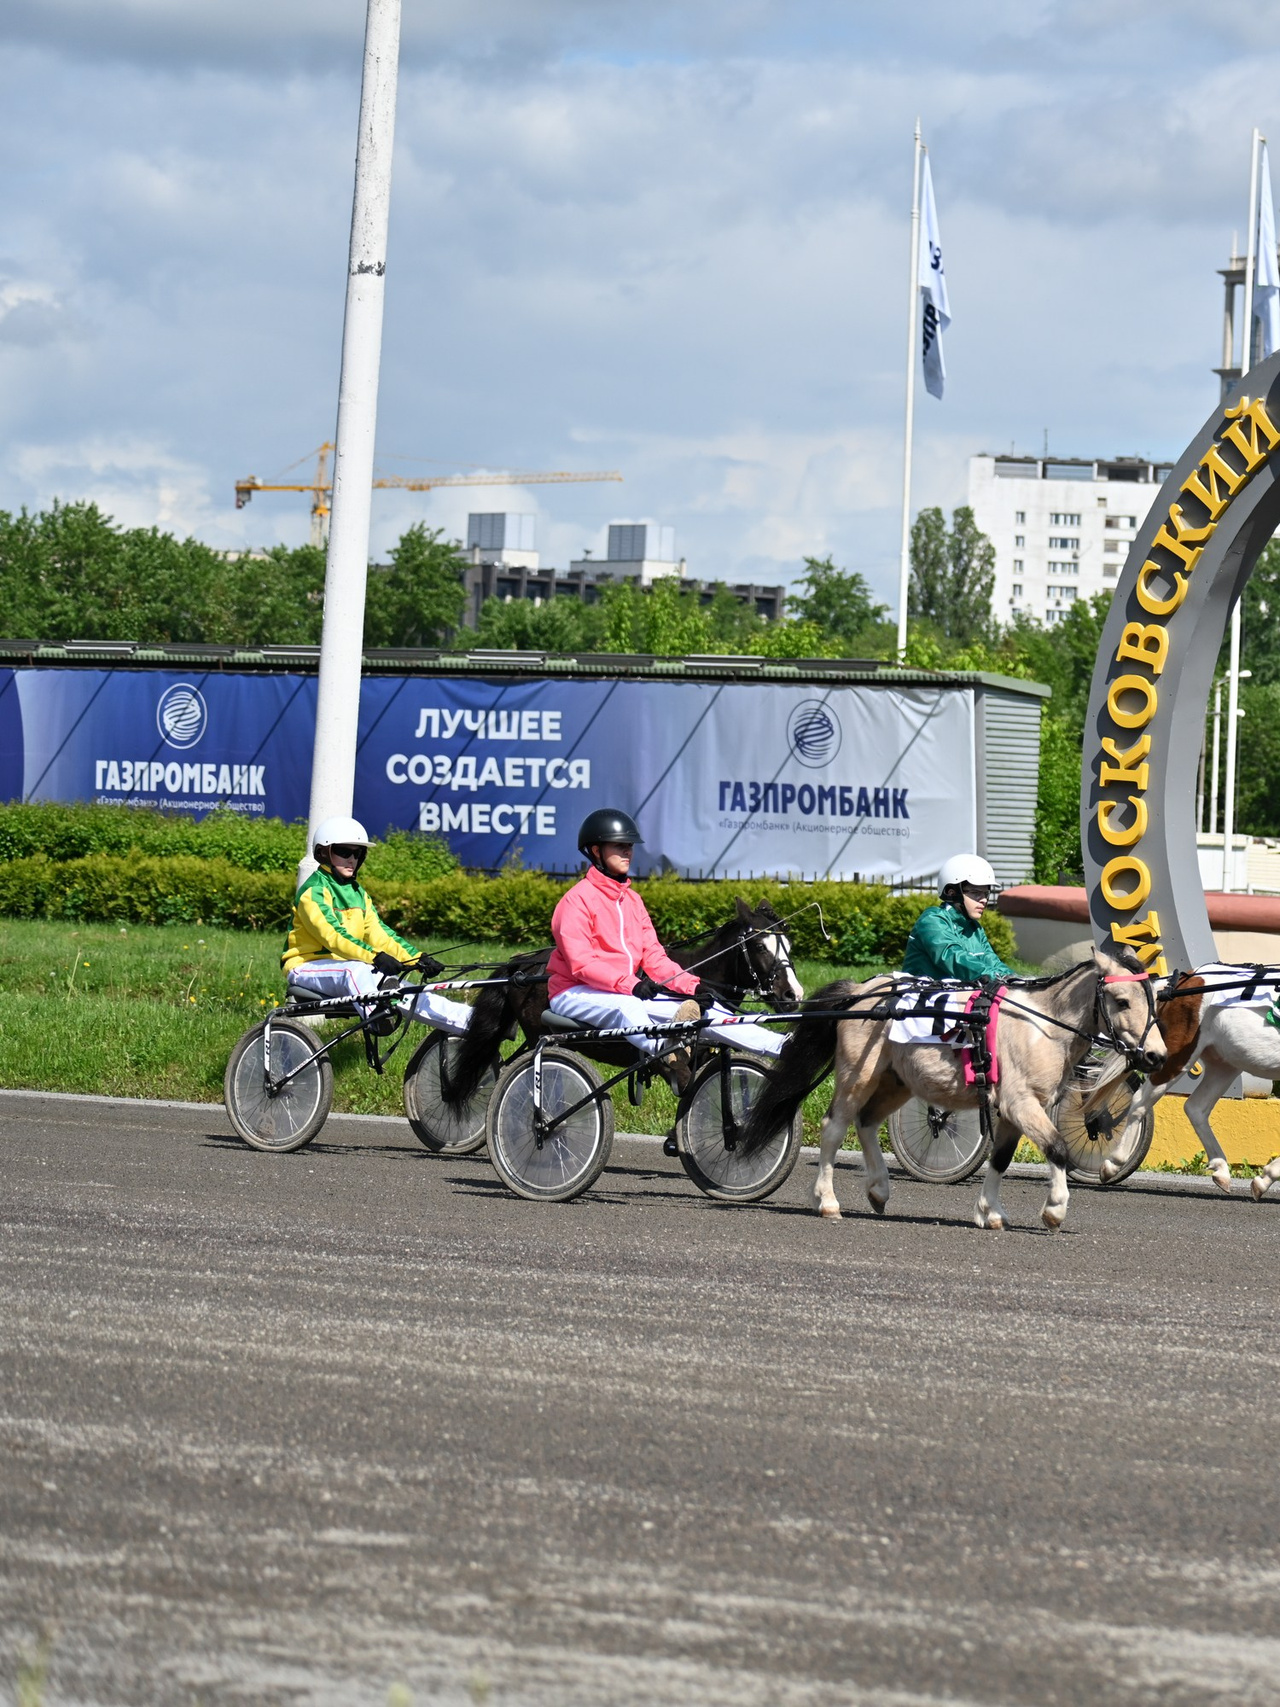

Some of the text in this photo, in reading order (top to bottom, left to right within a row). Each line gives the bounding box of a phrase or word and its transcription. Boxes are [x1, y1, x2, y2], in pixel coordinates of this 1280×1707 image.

[415, 708, 562, 741] ЛУЧШЕЕ
[95, 760, 266, 796] ГАЗПРОМБАНК
[385, 753, 591, 791] СОЗДАЕТСЯ
[718, 781, 911, 819] ГАЗПРОМБАНК
[418, 801, 557, 835] ВМЕСТЕ
[861, 825, 911, 839] общество)
[598, 1020, 699, 1037] FINNTACK
